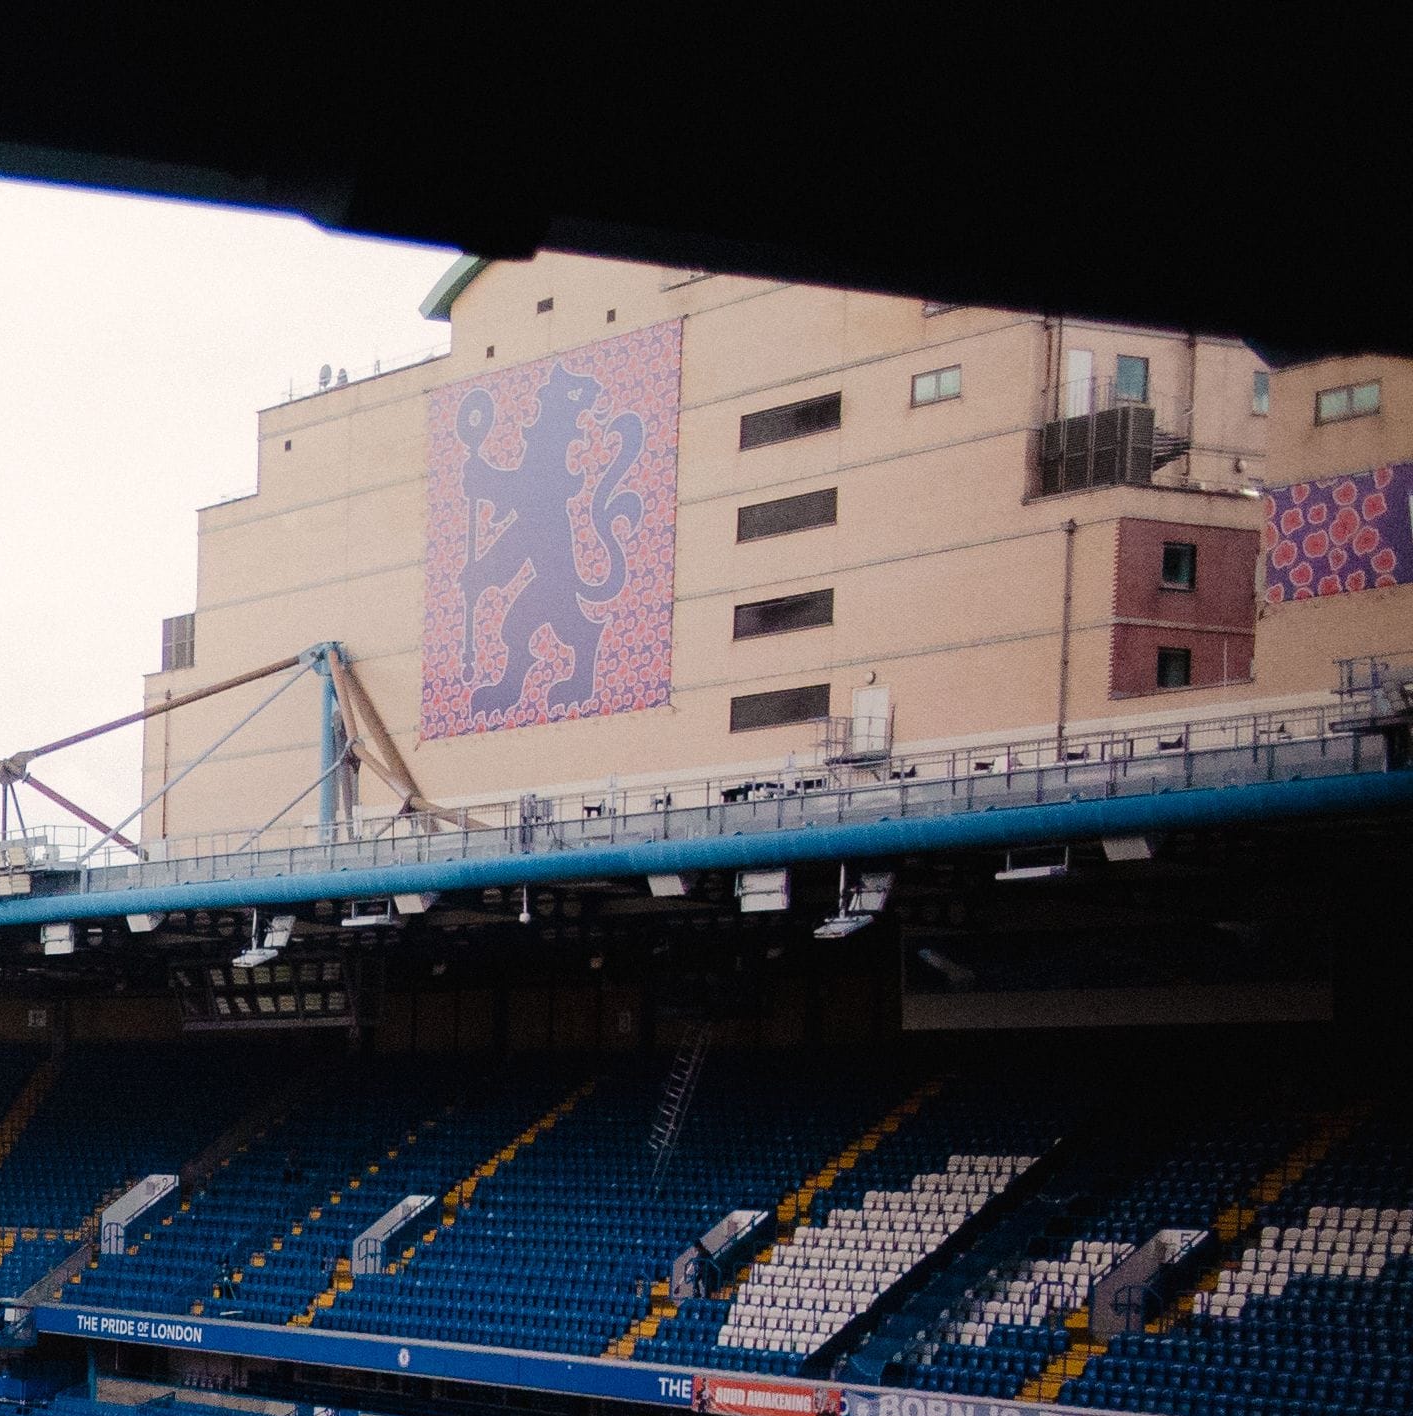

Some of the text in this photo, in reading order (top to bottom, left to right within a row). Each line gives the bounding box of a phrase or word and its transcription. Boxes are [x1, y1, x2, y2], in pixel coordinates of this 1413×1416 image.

[76, 1314, 202, 1343] THE PRIDE OF LONDON
[658, 1377, 693, 1399] THE
[747, 1390, 812, 1413] AWAKENING
